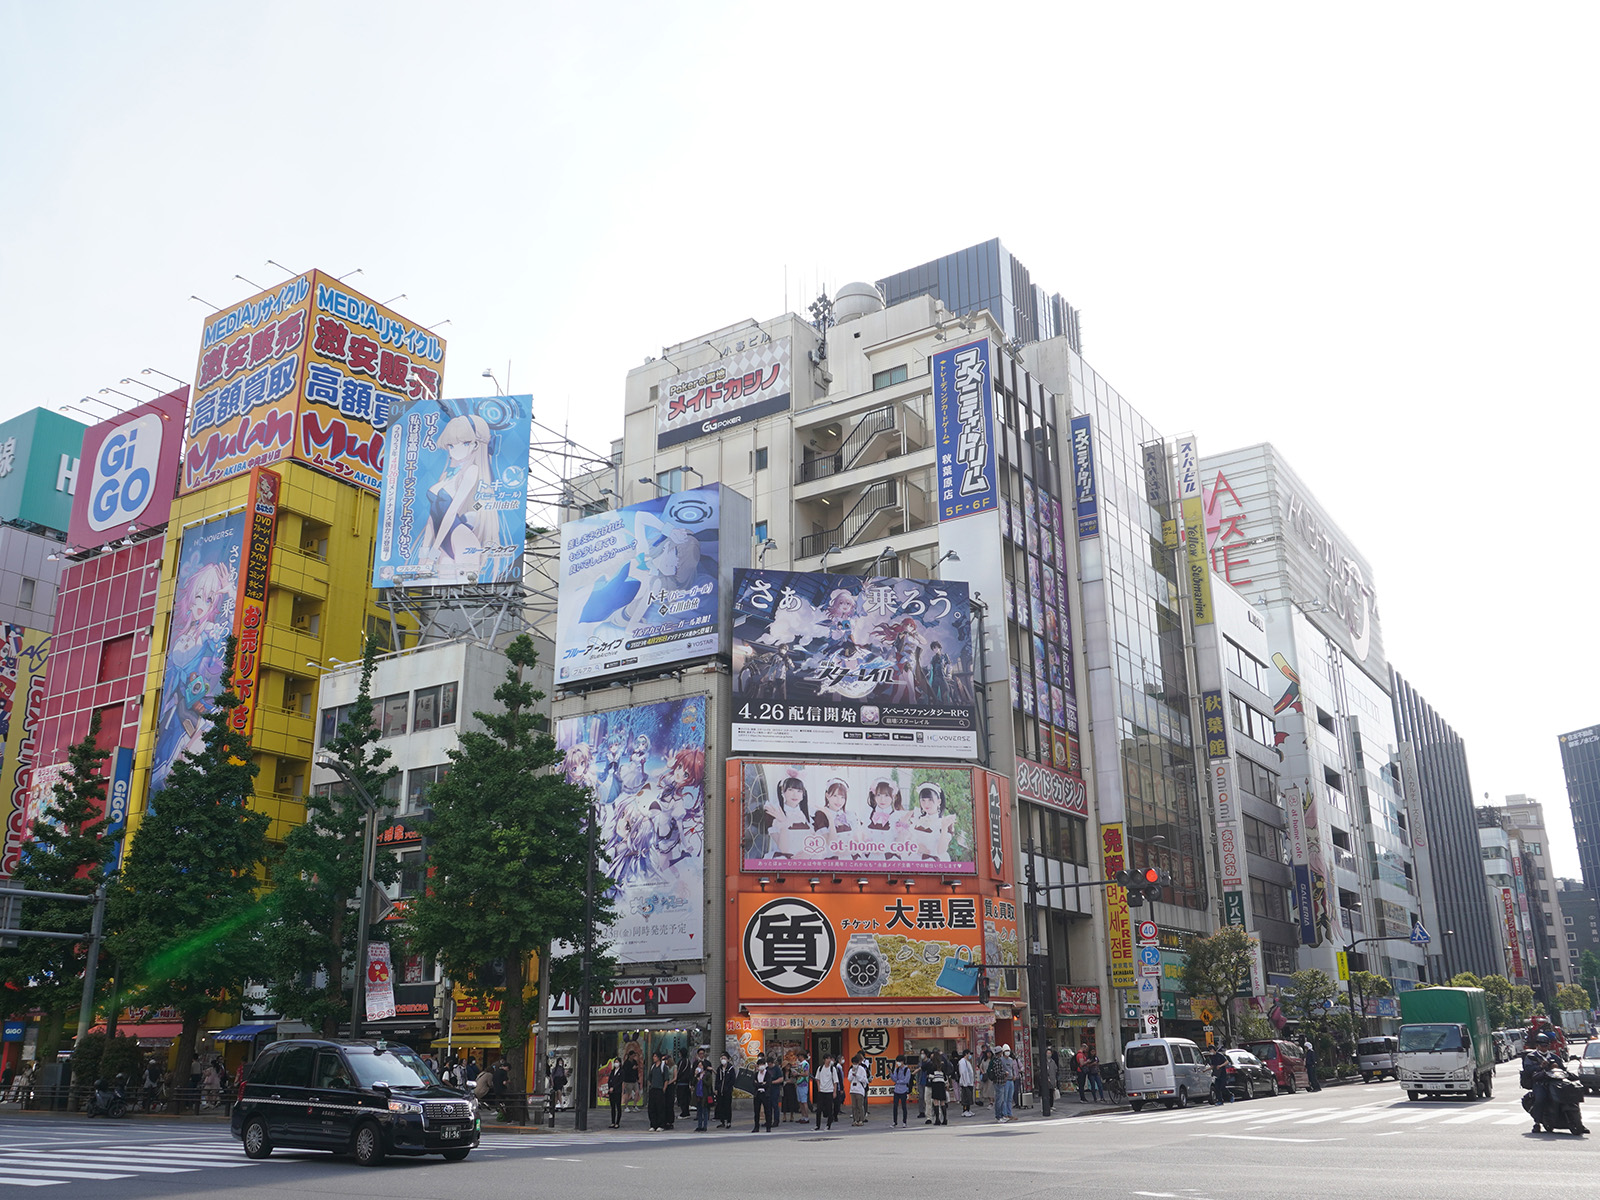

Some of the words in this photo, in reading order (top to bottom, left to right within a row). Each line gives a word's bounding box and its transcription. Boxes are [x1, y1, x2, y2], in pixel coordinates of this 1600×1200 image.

[203, 276, 310, 350] MEDIAリサイクル
[317, 283, 442, 362] MEDIAリサイクル
[199, 308, 306, 389] 激安販売
[190, 354, 298, 437] 高額買取
[668, 363, 780, 420] メイドカジノ
[186, 409, 294, 488] Mulan
[422, 413, 440, 452] びょん。
[942, 453, 953, 501] 秋葉原店
[1180, 442, 1196, 493] スーパービル
[255, 514, 271, 526] DVD
[1187, 524, 1198, 557] Yellow
[249, 560, 266, 571] アニメ
[254, 543, 266, 552] CD
[867, 584, 962, 620] 乗ろう。
[1191, 564, 1206, 619] Submarine
[231, 605, 261, 737] お売り下さ
[738, 703, 784, 721] 4.26
[788, 705, 857, 723] 配信開始
[882, 706, 969, 717] スペースファンタジーRPG
[1204, 695, 1225, 756] 秋葉館
[1017, 762, 1085, 809] メイドカジノ
[1216, 766, 1230, 820] amiami
[889, 840, 918, 854] cafe
[1221, 828, 1236, 877] あみあみ
[840, 918, 880, 930] チケット
[884, 898, 977, 930] 大黒屋
[984, 898, 1016, 921] 質&買取
[1300, 883, 1310, 927] GALLERIA
[756, 913, 826, 982] 質
[1121, 919, 1132, 959] FREE
[1143, 926, 1154, 935] 40
[1145, 951, 1153, 963] P
[589, 1006, 632, 1014] Akihabara
